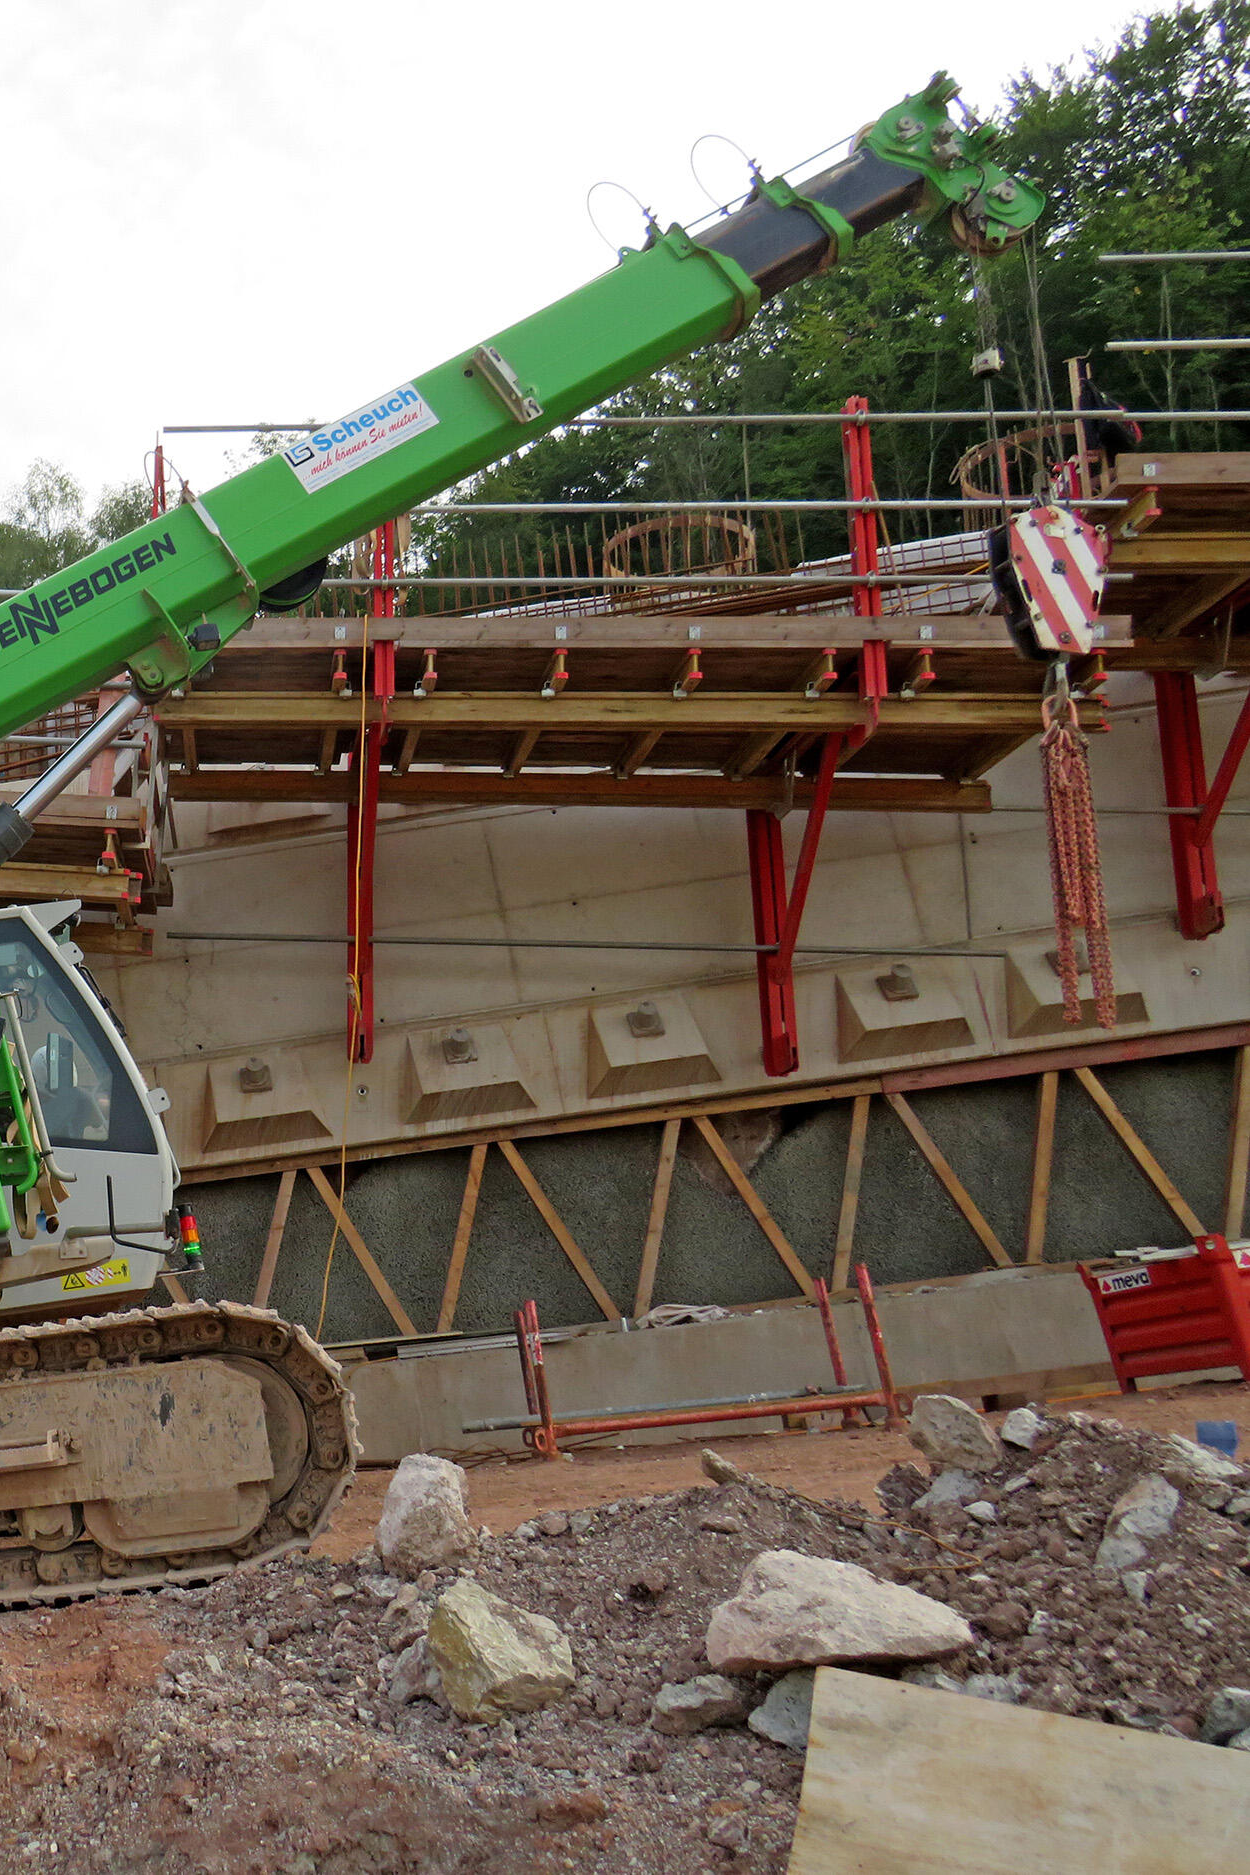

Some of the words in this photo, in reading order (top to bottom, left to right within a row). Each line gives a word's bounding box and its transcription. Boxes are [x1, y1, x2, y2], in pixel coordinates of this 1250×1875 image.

[312, 389, 419, 452] Scheuch
[334, 438, 368, 462] können
[368, 427, 387, 444] Sie
[1111, 1271, 1150, 1291] meva
